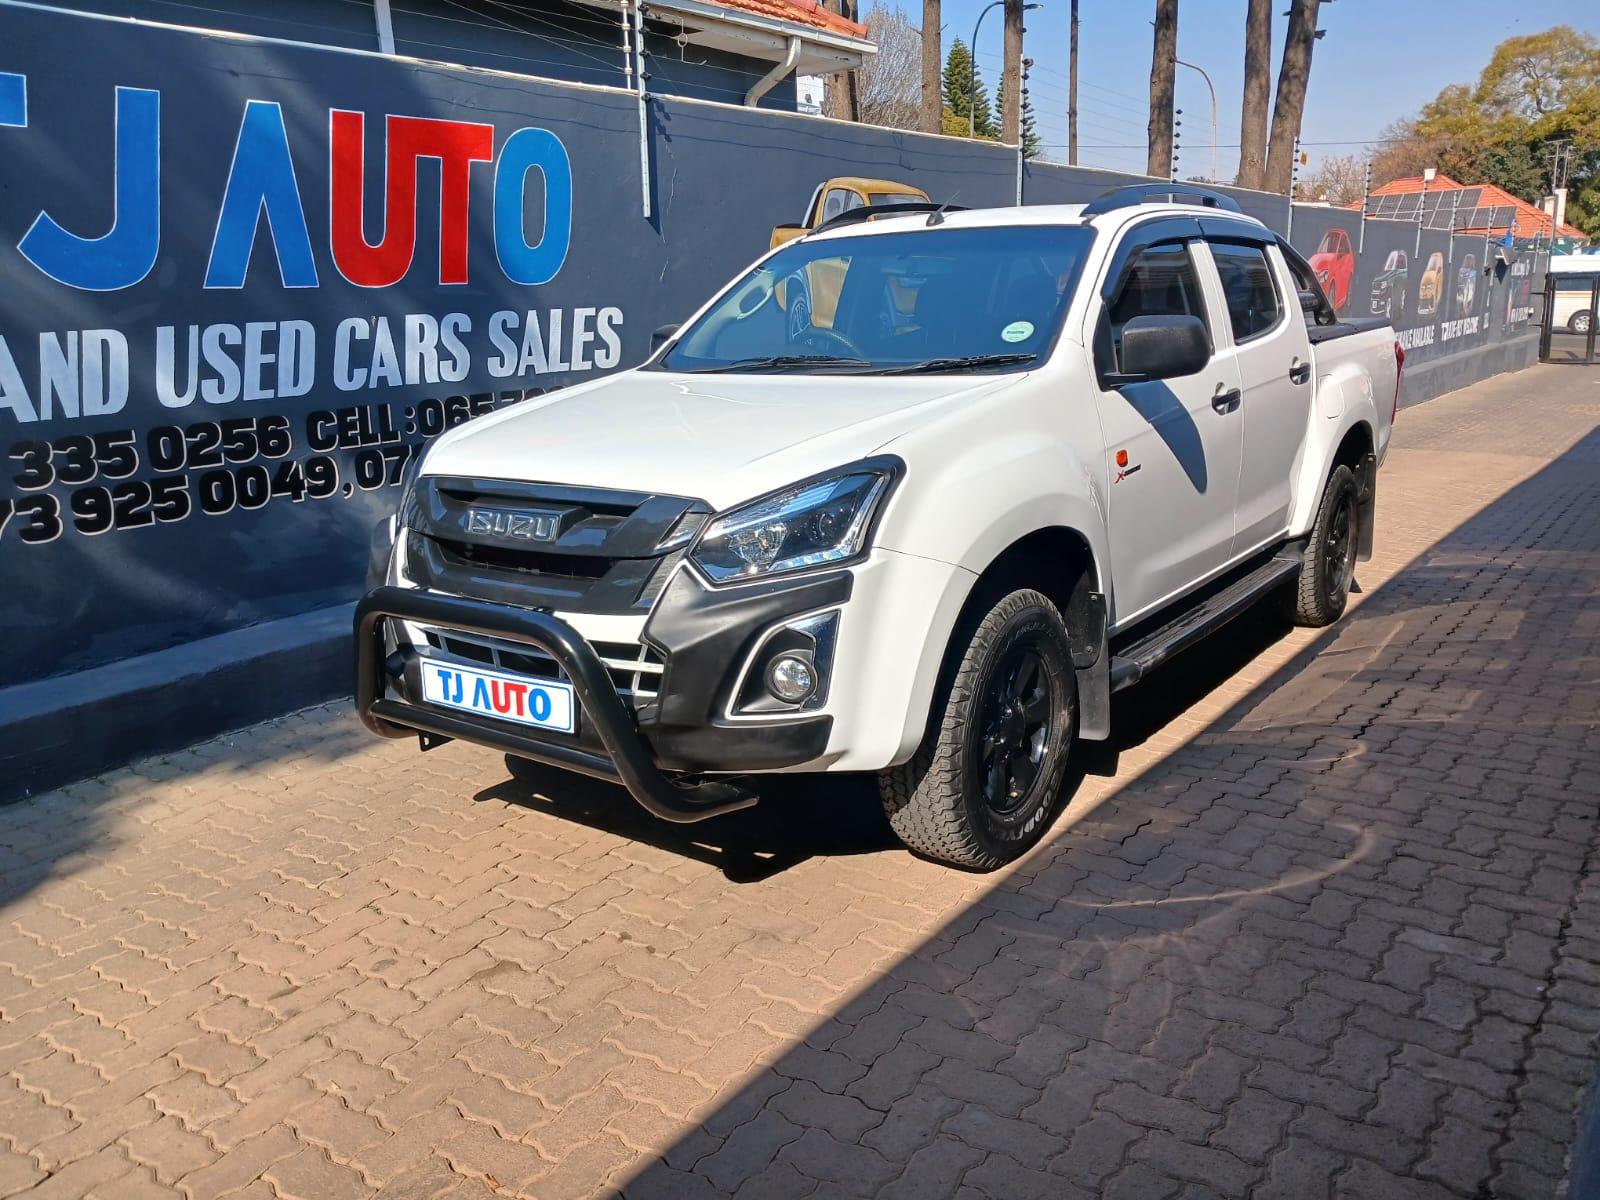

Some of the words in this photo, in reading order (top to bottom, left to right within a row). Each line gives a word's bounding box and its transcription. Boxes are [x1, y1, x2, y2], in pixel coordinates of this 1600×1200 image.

[203, 98, 573, 289] AUTO
[155, 319, 316, 409] USED
[333, 312, 473, 392] CARS
[487, 306, 624, 378] SALES
[9, 429, 140, 491] 335
[147, 415, 293, 473] 0256
[70, 474, 192, 536] 925
[464, 509, 560, 542] ISUZU
[437, 669, 464, 704] TJ
[472, 677, 553, 722] AUTO
